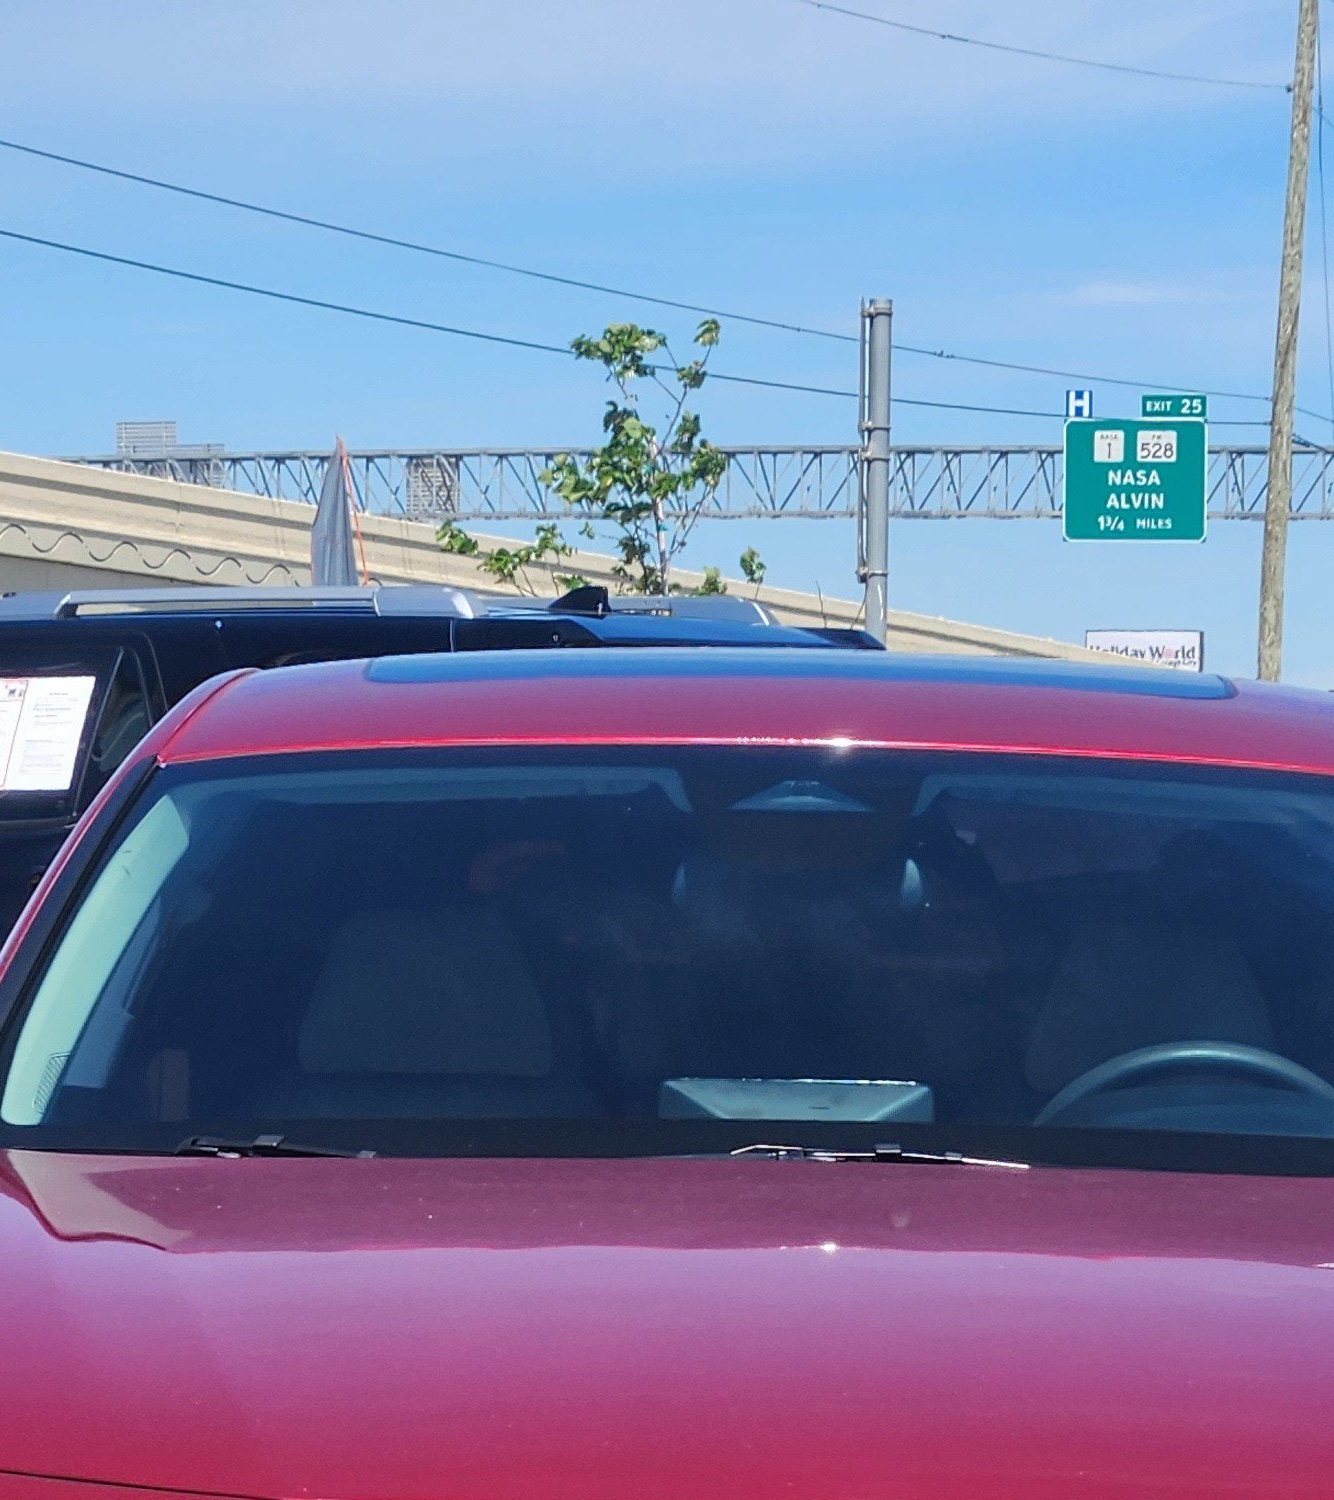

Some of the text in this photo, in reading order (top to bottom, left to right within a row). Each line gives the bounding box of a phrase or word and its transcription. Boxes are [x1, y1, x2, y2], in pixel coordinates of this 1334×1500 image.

[1068, 390, 1090, 418] H
[1146, 398, 1203, 414] EXIT 25
[1139, 442, 1174, 460] 528
[1107, 469, 1161, 486] NASA
[1106, 492, 1165, 510] ALVIN
[1135, 516, 1173, 530] MILES
